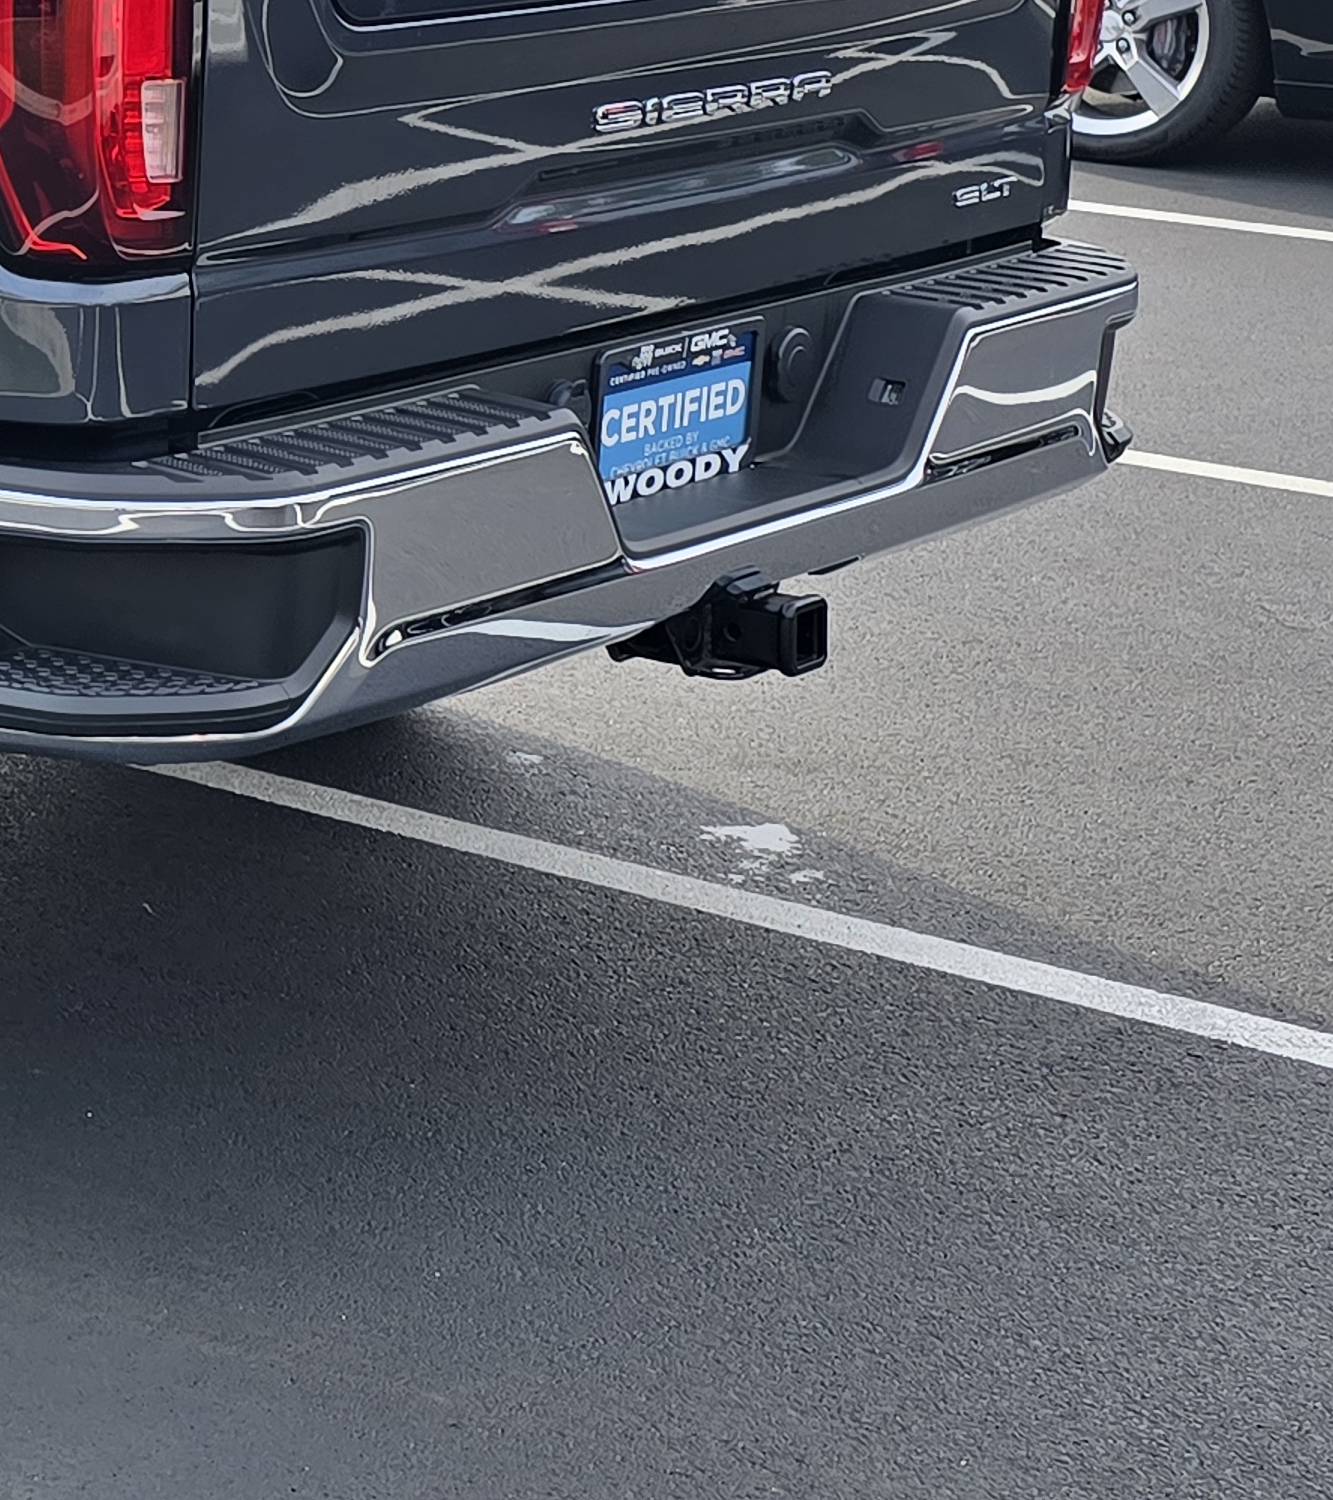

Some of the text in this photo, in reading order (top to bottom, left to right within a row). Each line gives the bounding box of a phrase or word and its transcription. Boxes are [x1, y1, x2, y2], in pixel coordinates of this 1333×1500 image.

[592, 70, 833, 133] SIERRA
[953, 176, 1018, 207] SLT
[654, 343, 683, 358] BUICK
[690, 328, 729, 352] GMC
[600, 378, 746, 448] CERTIFIED
[644, 431, 700, 457] BACKED BY
[603, 443, 750, 506] WOODY
